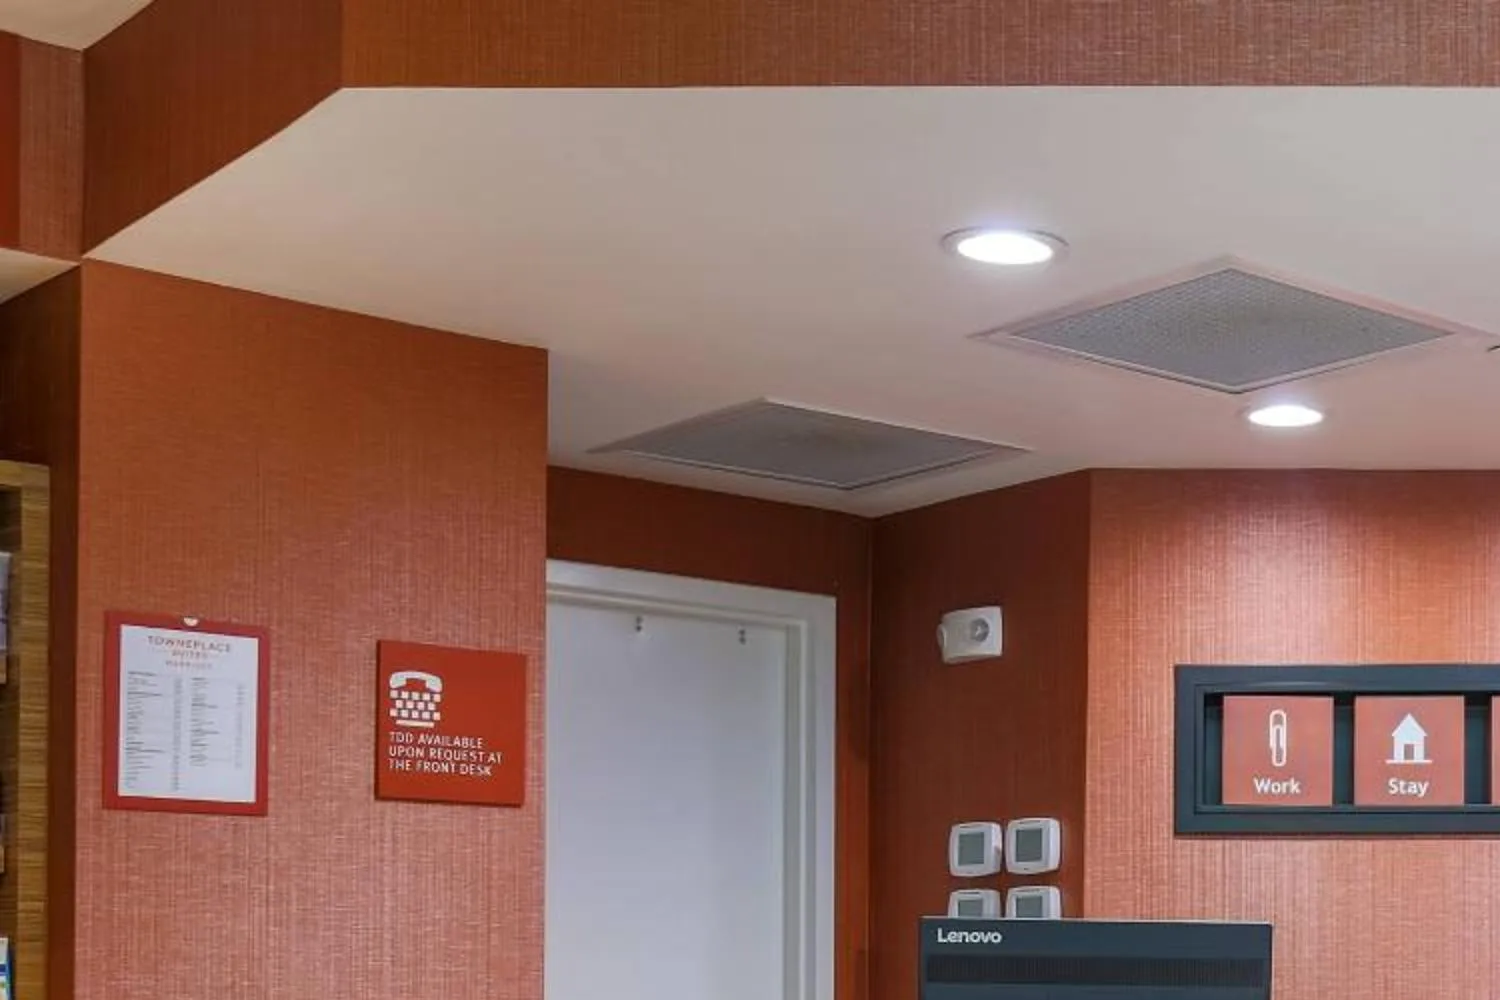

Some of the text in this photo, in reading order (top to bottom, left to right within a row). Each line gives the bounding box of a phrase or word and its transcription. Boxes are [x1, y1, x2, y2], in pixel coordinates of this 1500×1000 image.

[388, 731, 483, 749] TDD AVAILABLE
[388, 745, 502, 764] UPON REQUEST AT
[388, 759, 492, 776] THE FRONT DESK
[1253, 777, 1301, 795] Work
[1387, 777, 1429, 797] Stay
[937, 927, 1002, 944] Lenovo
